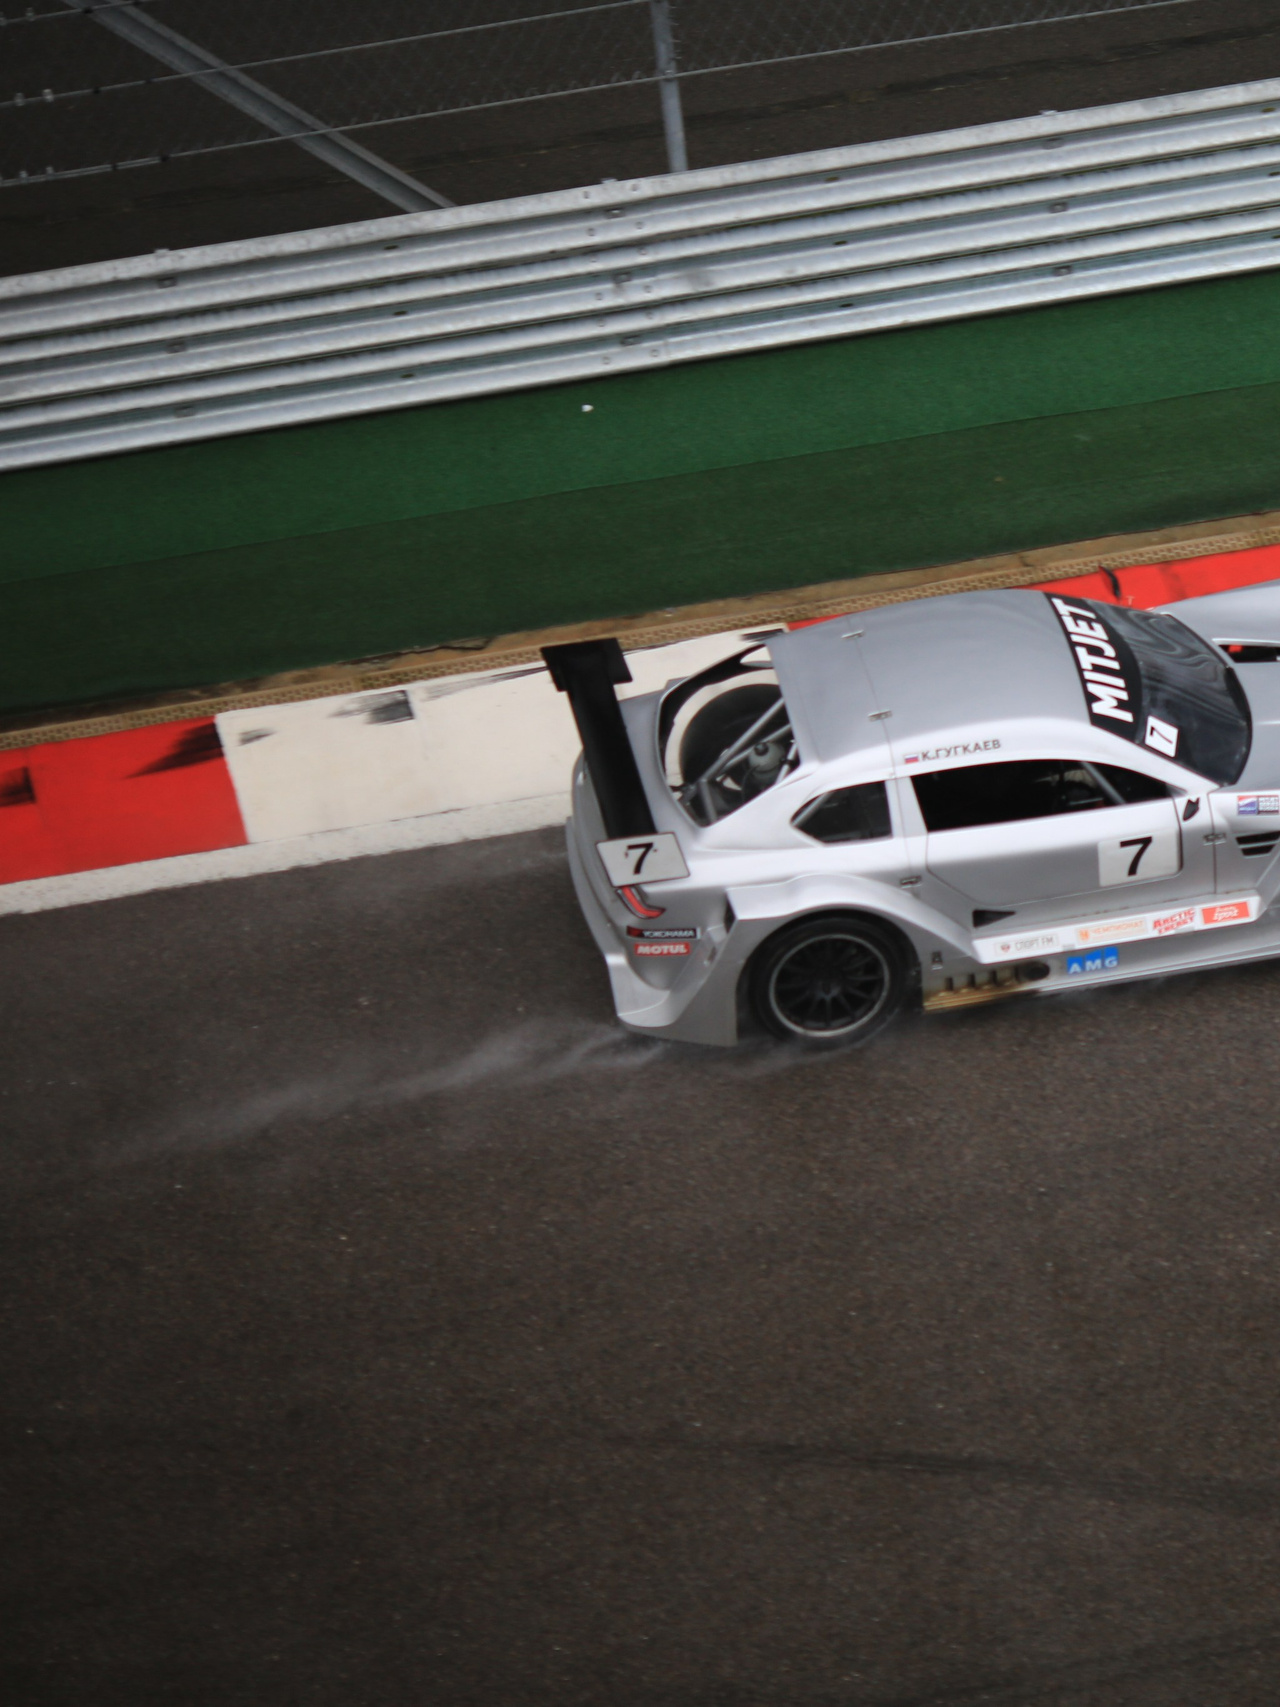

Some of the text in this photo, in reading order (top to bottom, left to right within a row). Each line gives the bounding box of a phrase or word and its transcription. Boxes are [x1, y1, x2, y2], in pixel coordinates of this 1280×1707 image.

[1051, 597, 1134, 723] MITJET
[1150, 725, 1174, 745] 7
[626, 842, 654, 875] 7
[1119, 835, 1153, 877] 7
[642, 929, 695, 939] YOKOHAMA
[636, 944, 689, 955] MOTUL
